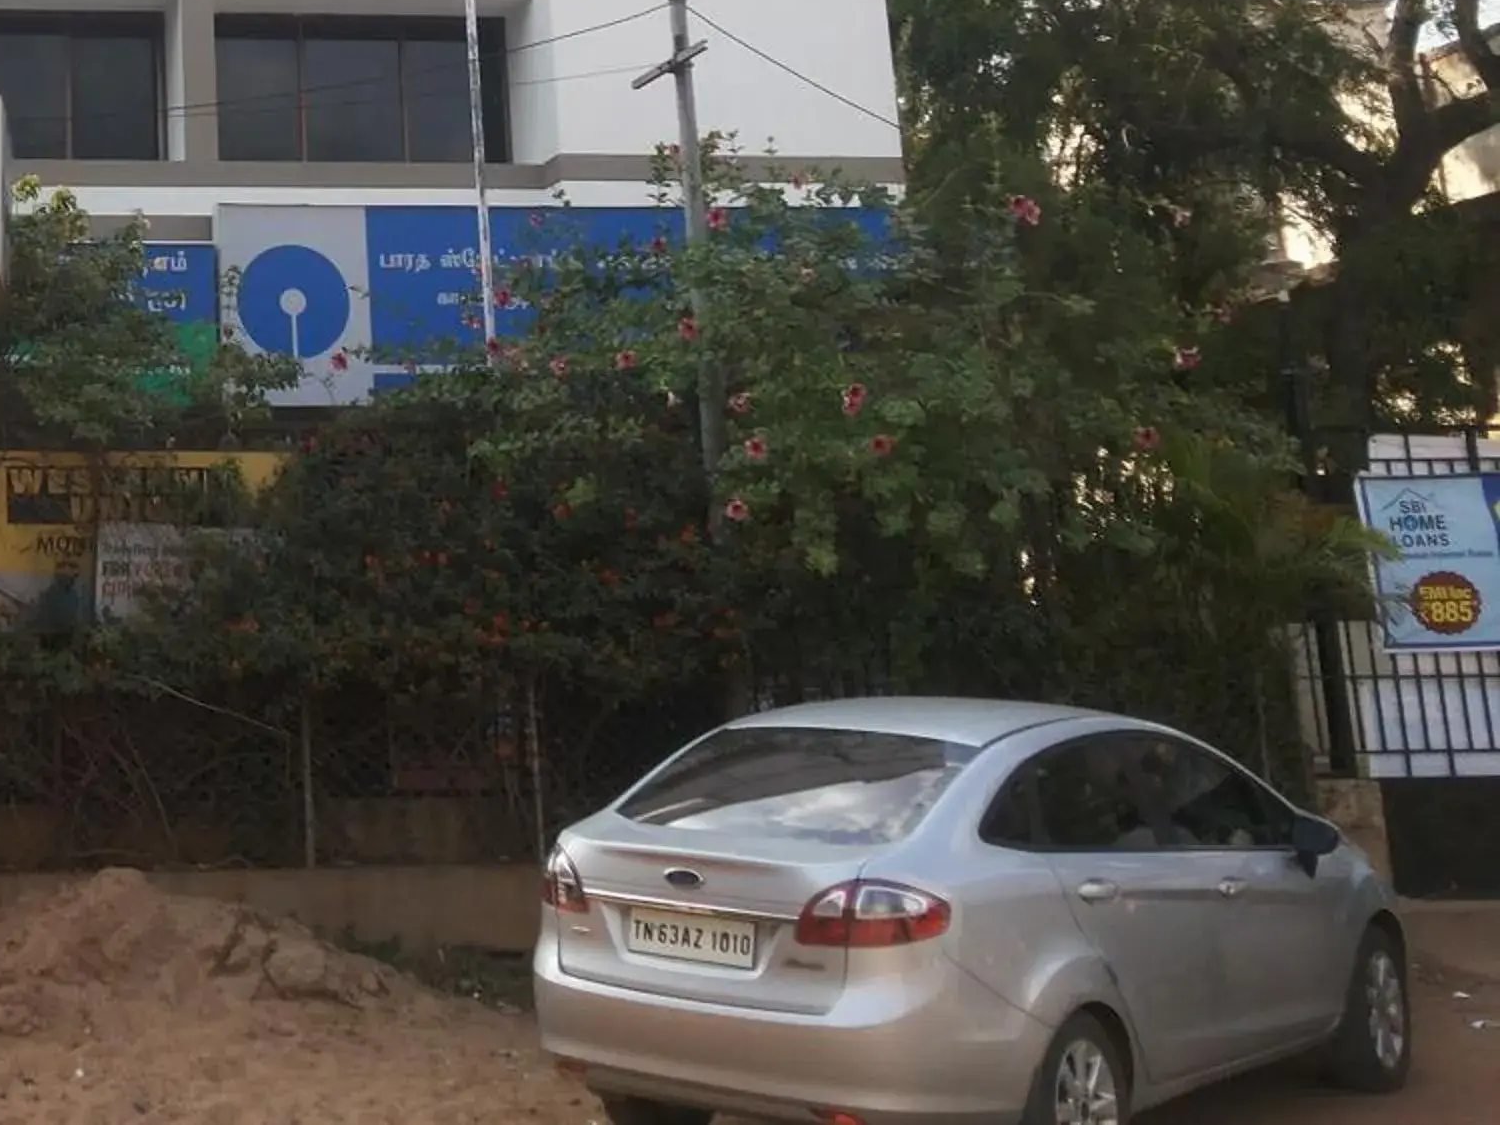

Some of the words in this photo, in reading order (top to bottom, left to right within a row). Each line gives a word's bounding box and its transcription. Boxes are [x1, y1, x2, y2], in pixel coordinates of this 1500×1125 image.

[1399, 499, 1427, 514] SBI
[1389, 514, 1447, 532] HOME
[1392, 534, 1451, 548] LOANS
[711, 930, 751, 957] 1010
